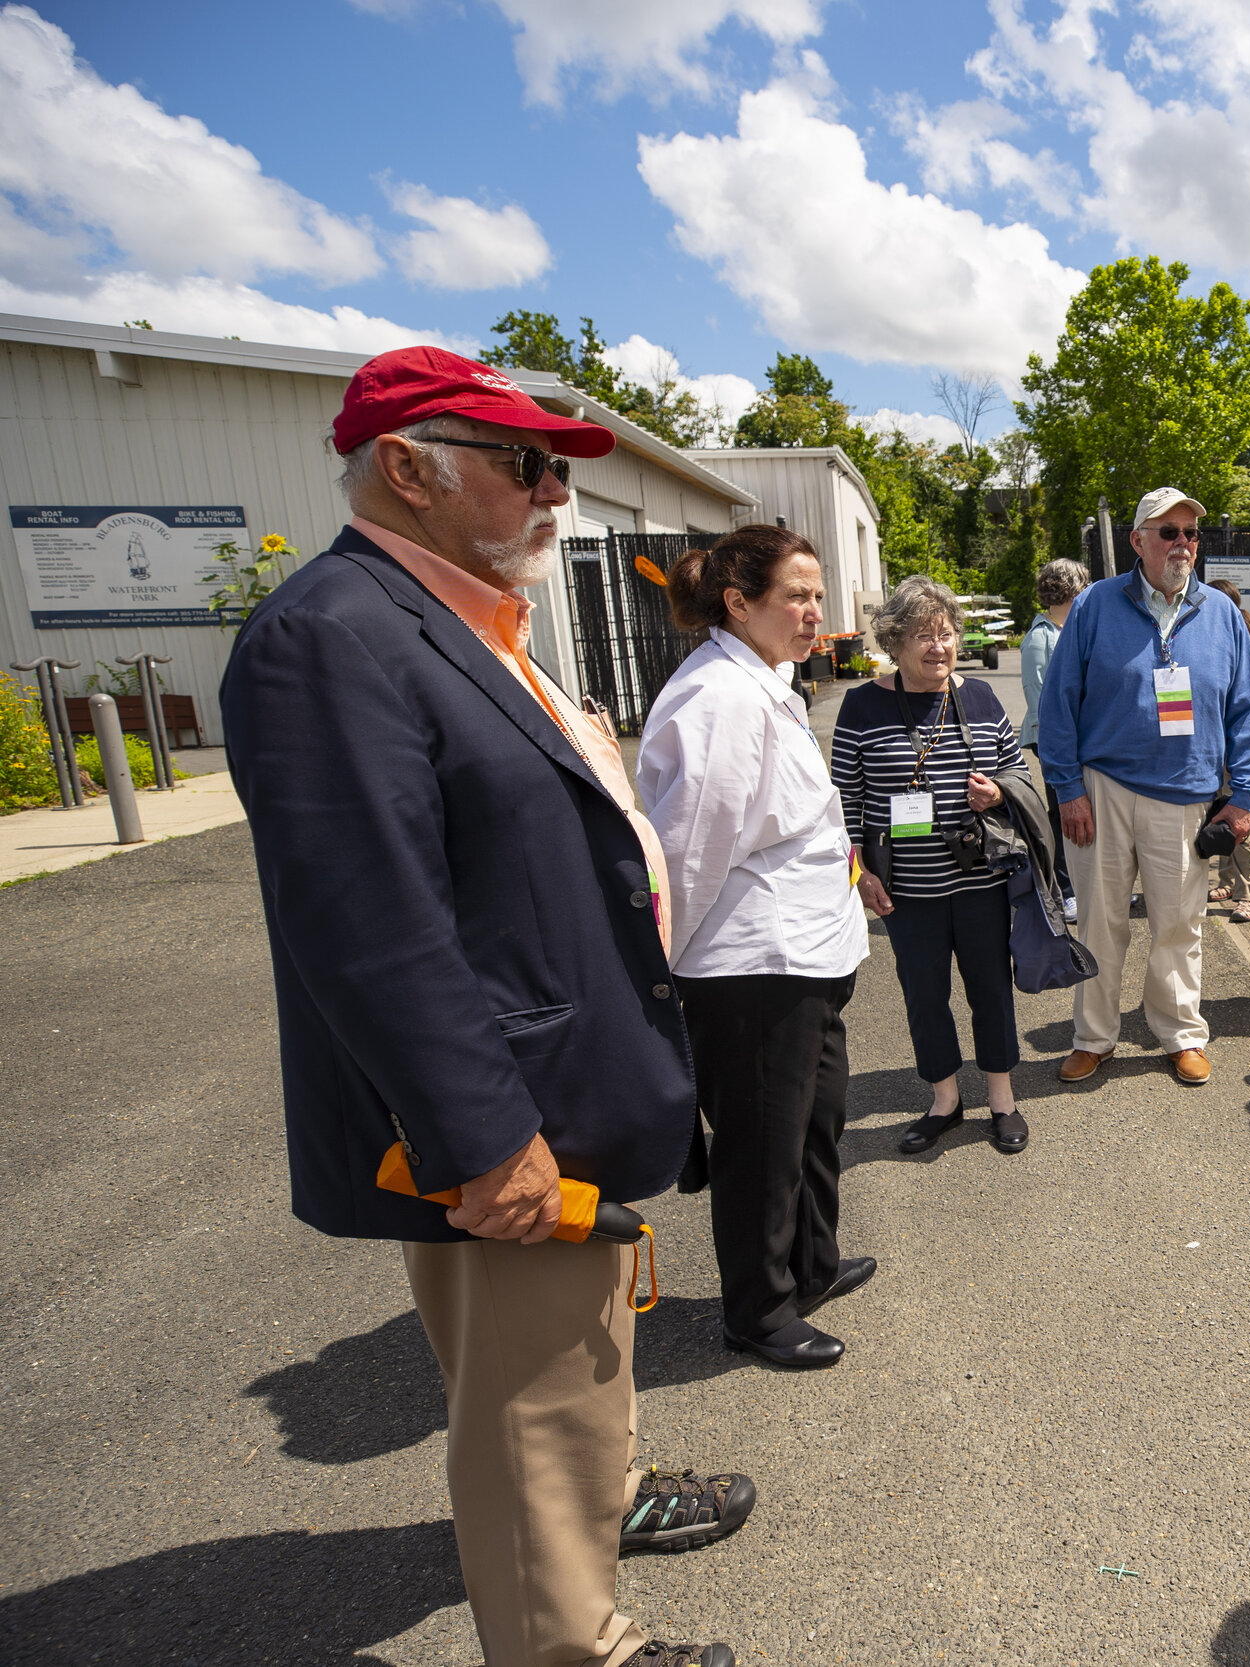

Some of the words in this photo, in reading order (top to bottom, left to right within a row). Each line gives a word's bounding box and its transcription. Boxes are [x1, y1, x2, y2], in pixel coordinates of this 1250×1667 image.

[95, 516, 172, 541] BLADENSBURG
[107, 585, 178, 595] WATERFRONT
[131, 594, 160, 602] PARK
